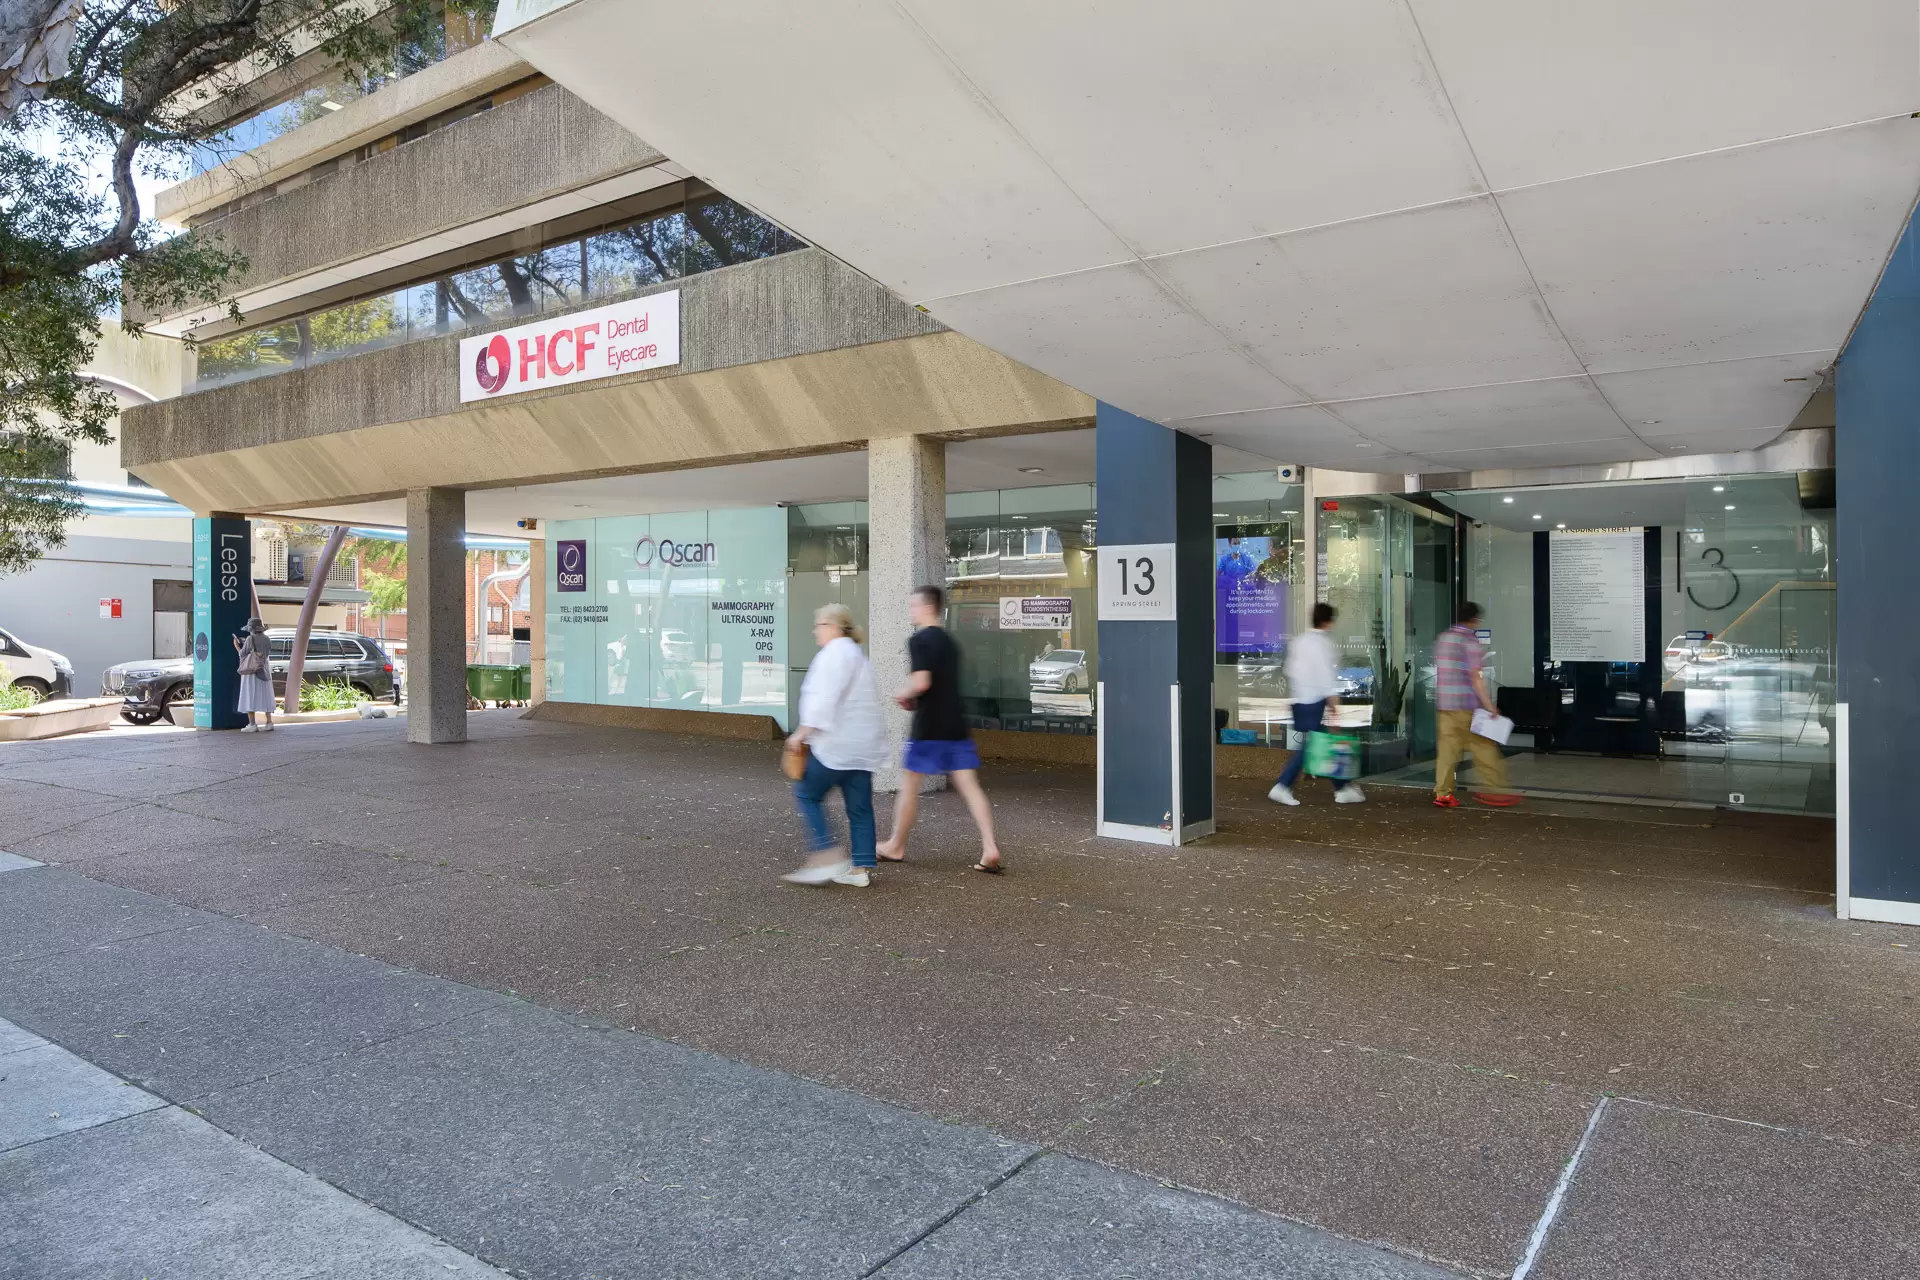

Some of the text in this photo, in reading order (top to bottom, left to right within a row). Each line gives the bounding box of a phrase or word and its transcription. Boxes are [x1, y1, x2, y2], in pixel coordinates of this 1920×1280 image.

[608, 312, 649, 339] Dental
[518, 323, 600, 382] HCF
[608, 343, 657, 371] Eyecare
[659, 539, 715, 567] Qscan
[221, 534, 243, 601] Lease
[1677, 531, 1740, 611] 13
[559, 572, 584, 586] Qscan
[1117, 557, 1155, 596] 13
[573, 605, 582, 615] (02)
[595, 605, 608, 613] 2700
[712, 602, 775, 611] MAMMOGRAPHY
[573, 615, 582, 624] (02)
[721, 615, 775, 624] ULTRASOUND
[1000, 617, 1021, 626] Qscan
[750, 628, 775, 637] X-RAY
[755, 641, 773, 651] OPG
[758, 655, 773, 664] MRI
[762, 668, 773, 678] CT
